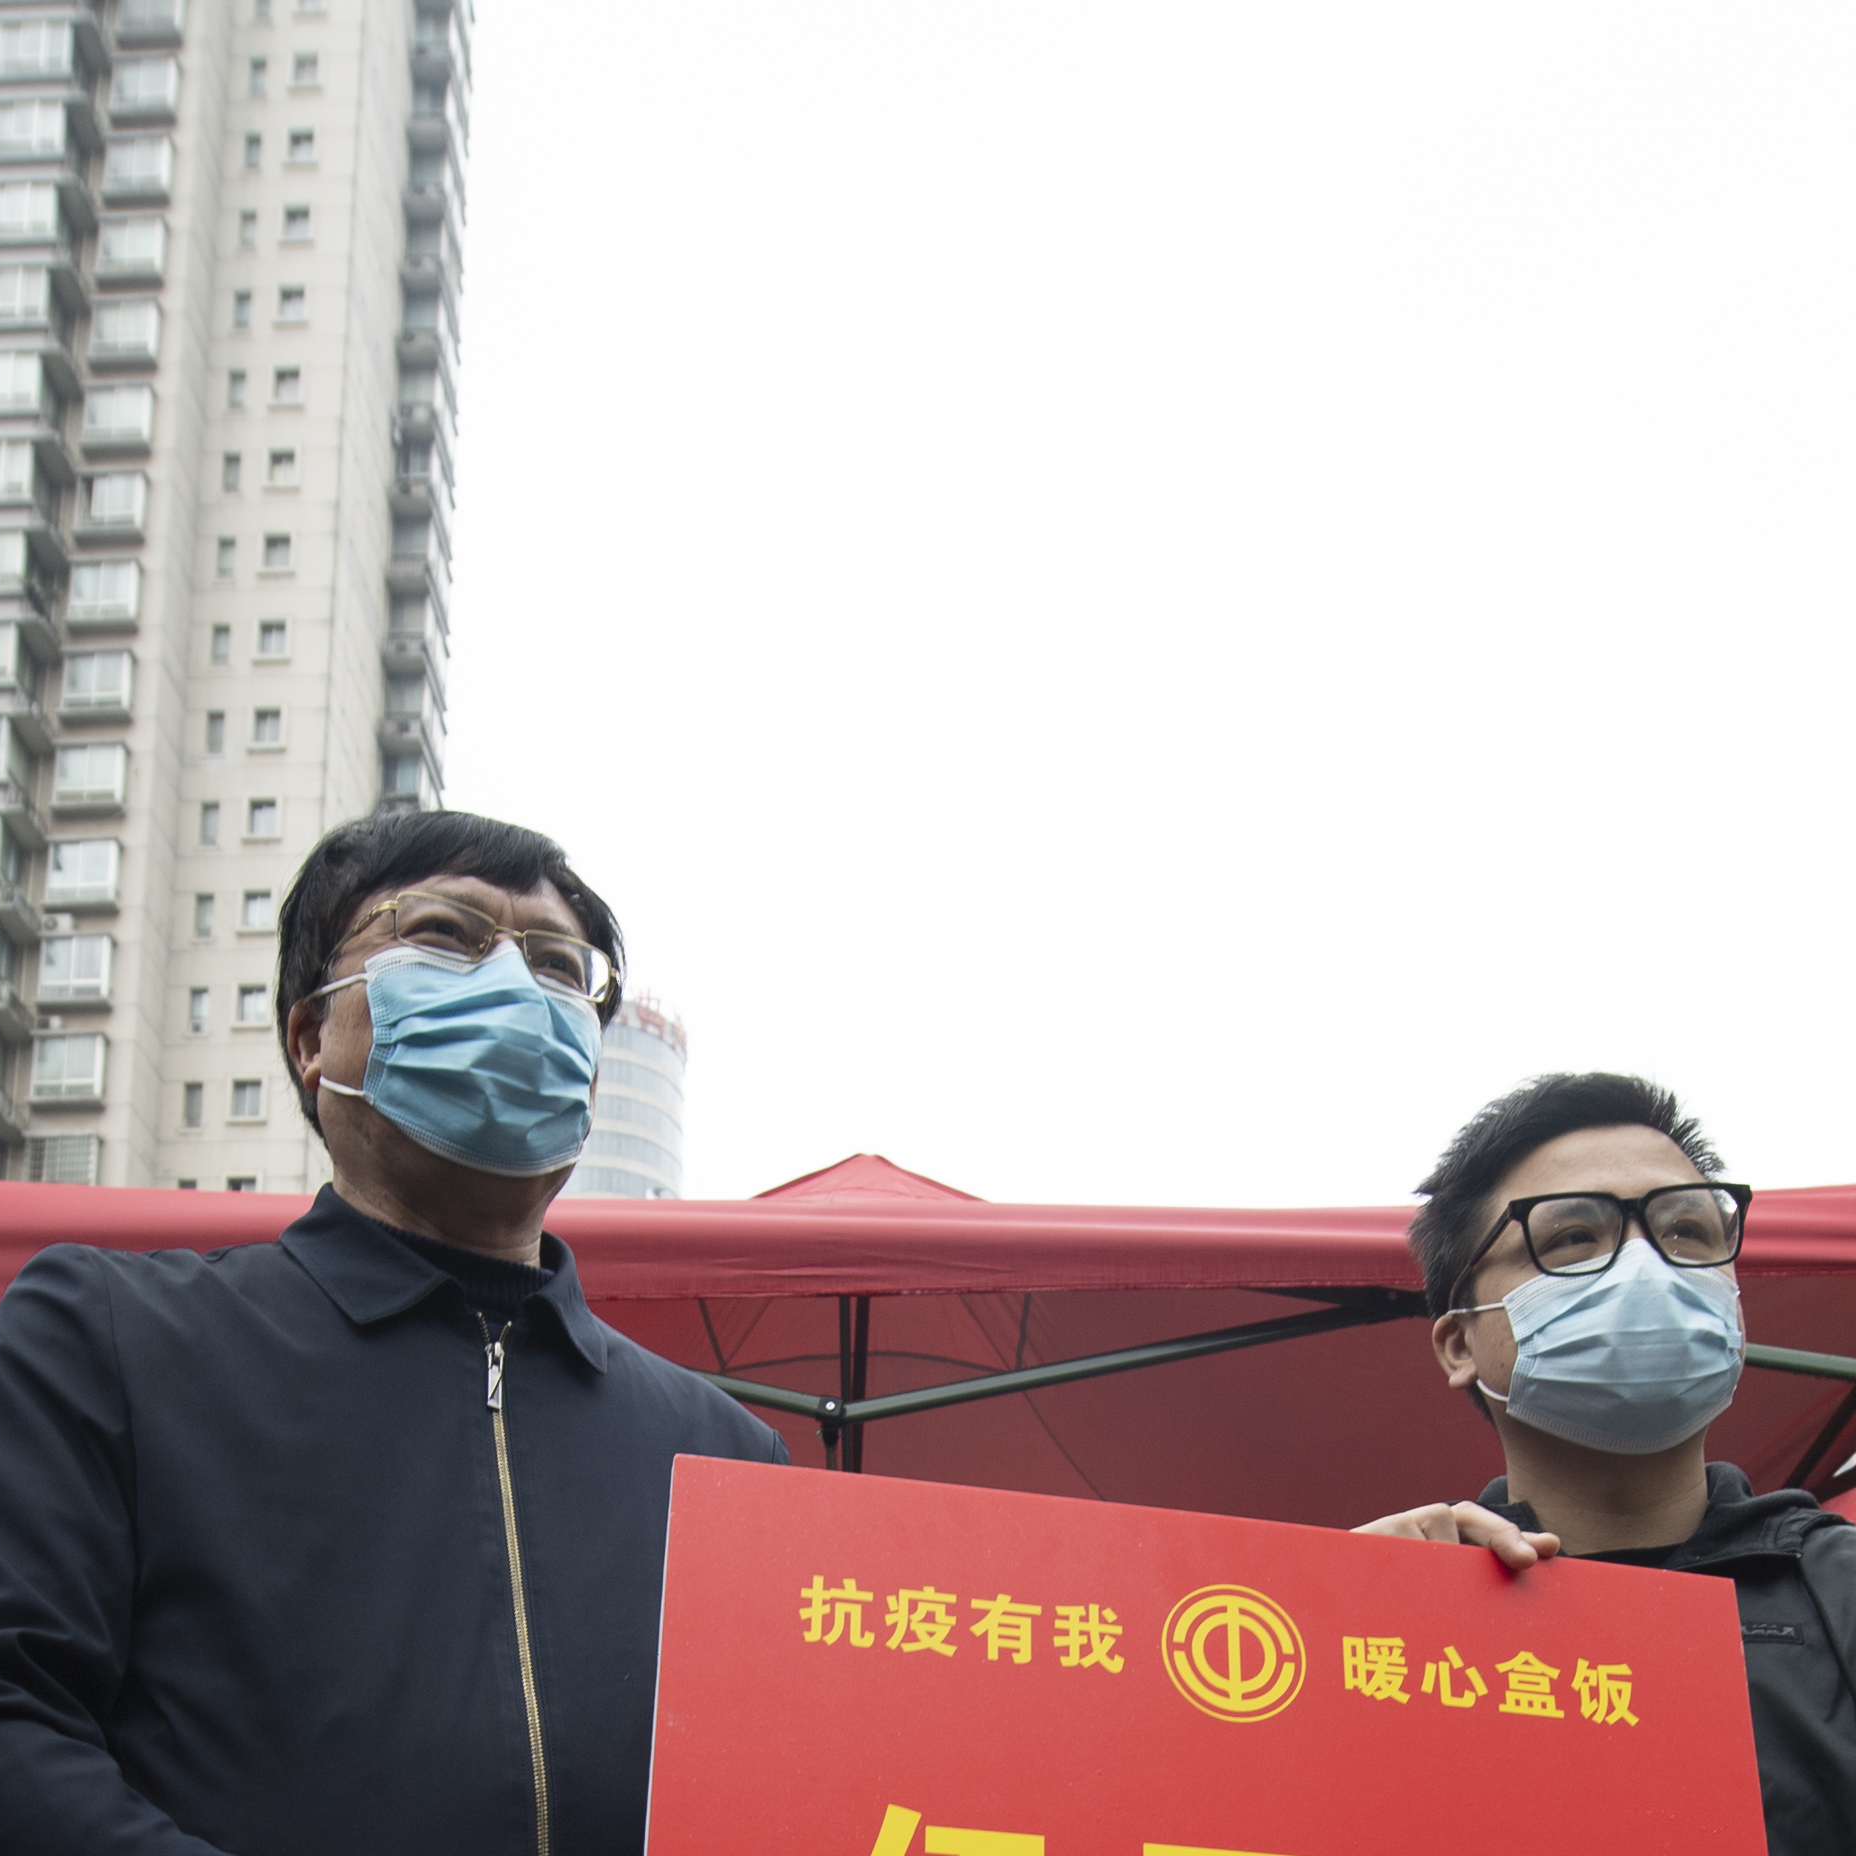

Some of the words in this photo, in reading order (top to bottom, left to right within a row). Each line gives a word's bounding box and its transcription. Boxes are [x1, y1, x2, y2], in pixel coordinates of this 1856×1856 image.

[798, 1574, 1125, 1674] 抗疫有我
[1341, 1634, 1640, 1728] 暖心盒饭
